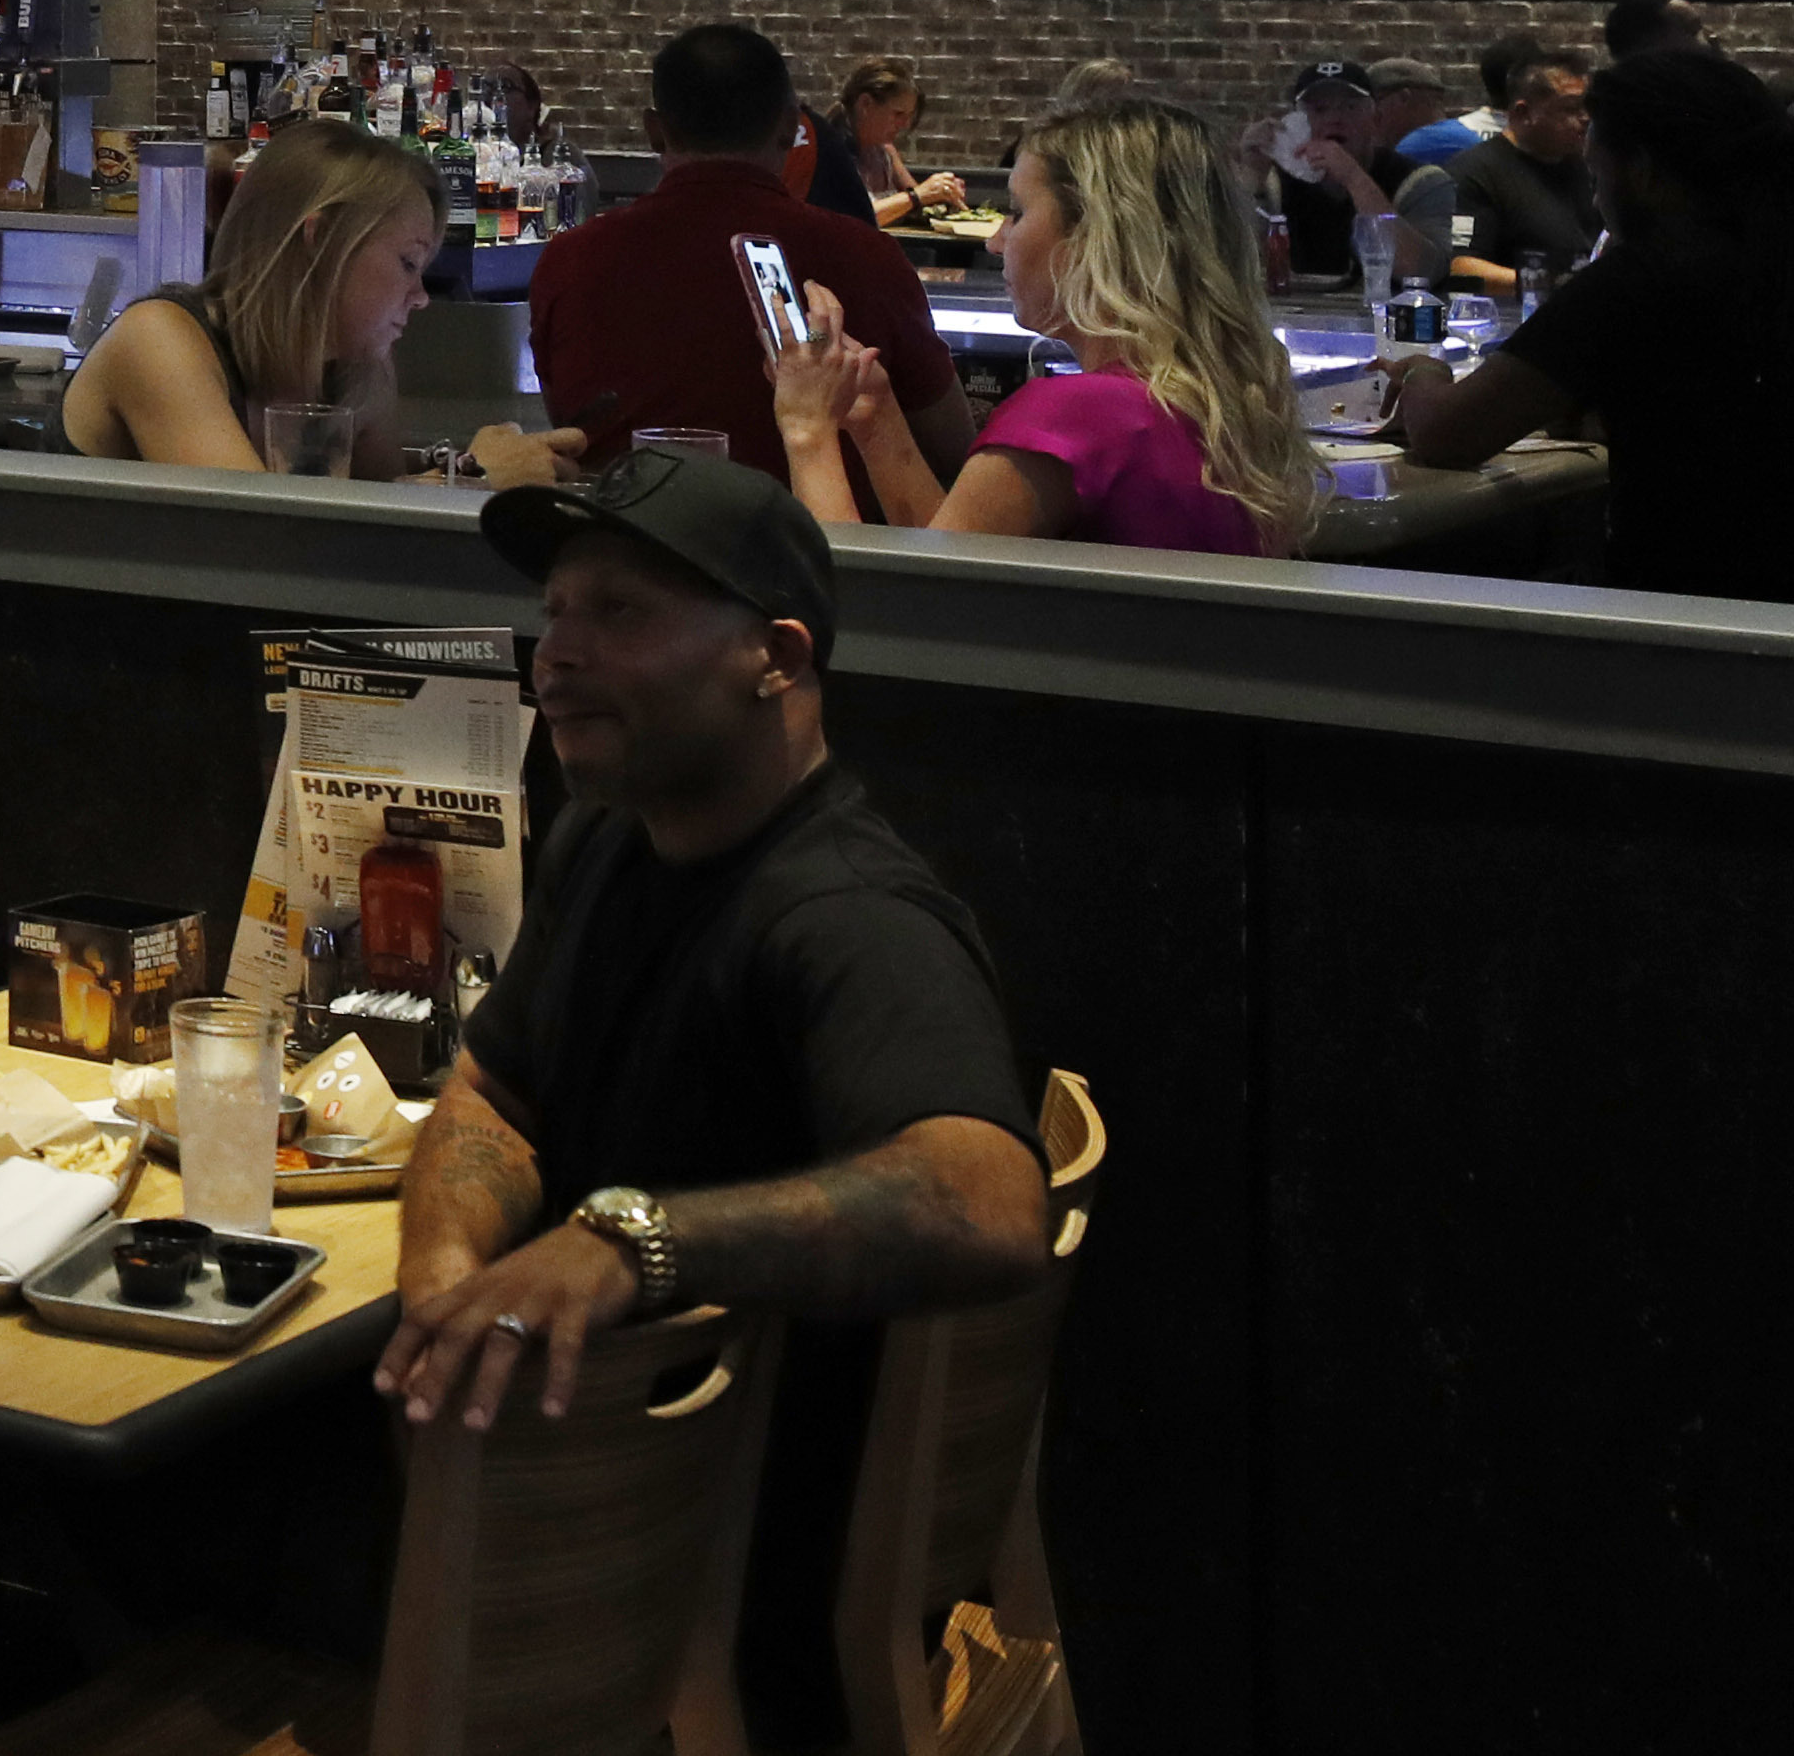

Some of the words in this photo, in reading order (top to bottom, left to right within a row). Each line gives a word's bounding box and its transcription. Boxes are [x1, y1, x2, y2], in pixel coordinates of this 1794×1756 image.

[440, 166, 474, 177] AMESON
[299, 669, 366, 693] DRAFTS
[301, 777, 404, 804] HAPPY
[414, 787, 503, 815] HOUR
[14, 934, 61, 955] PITCHERS
